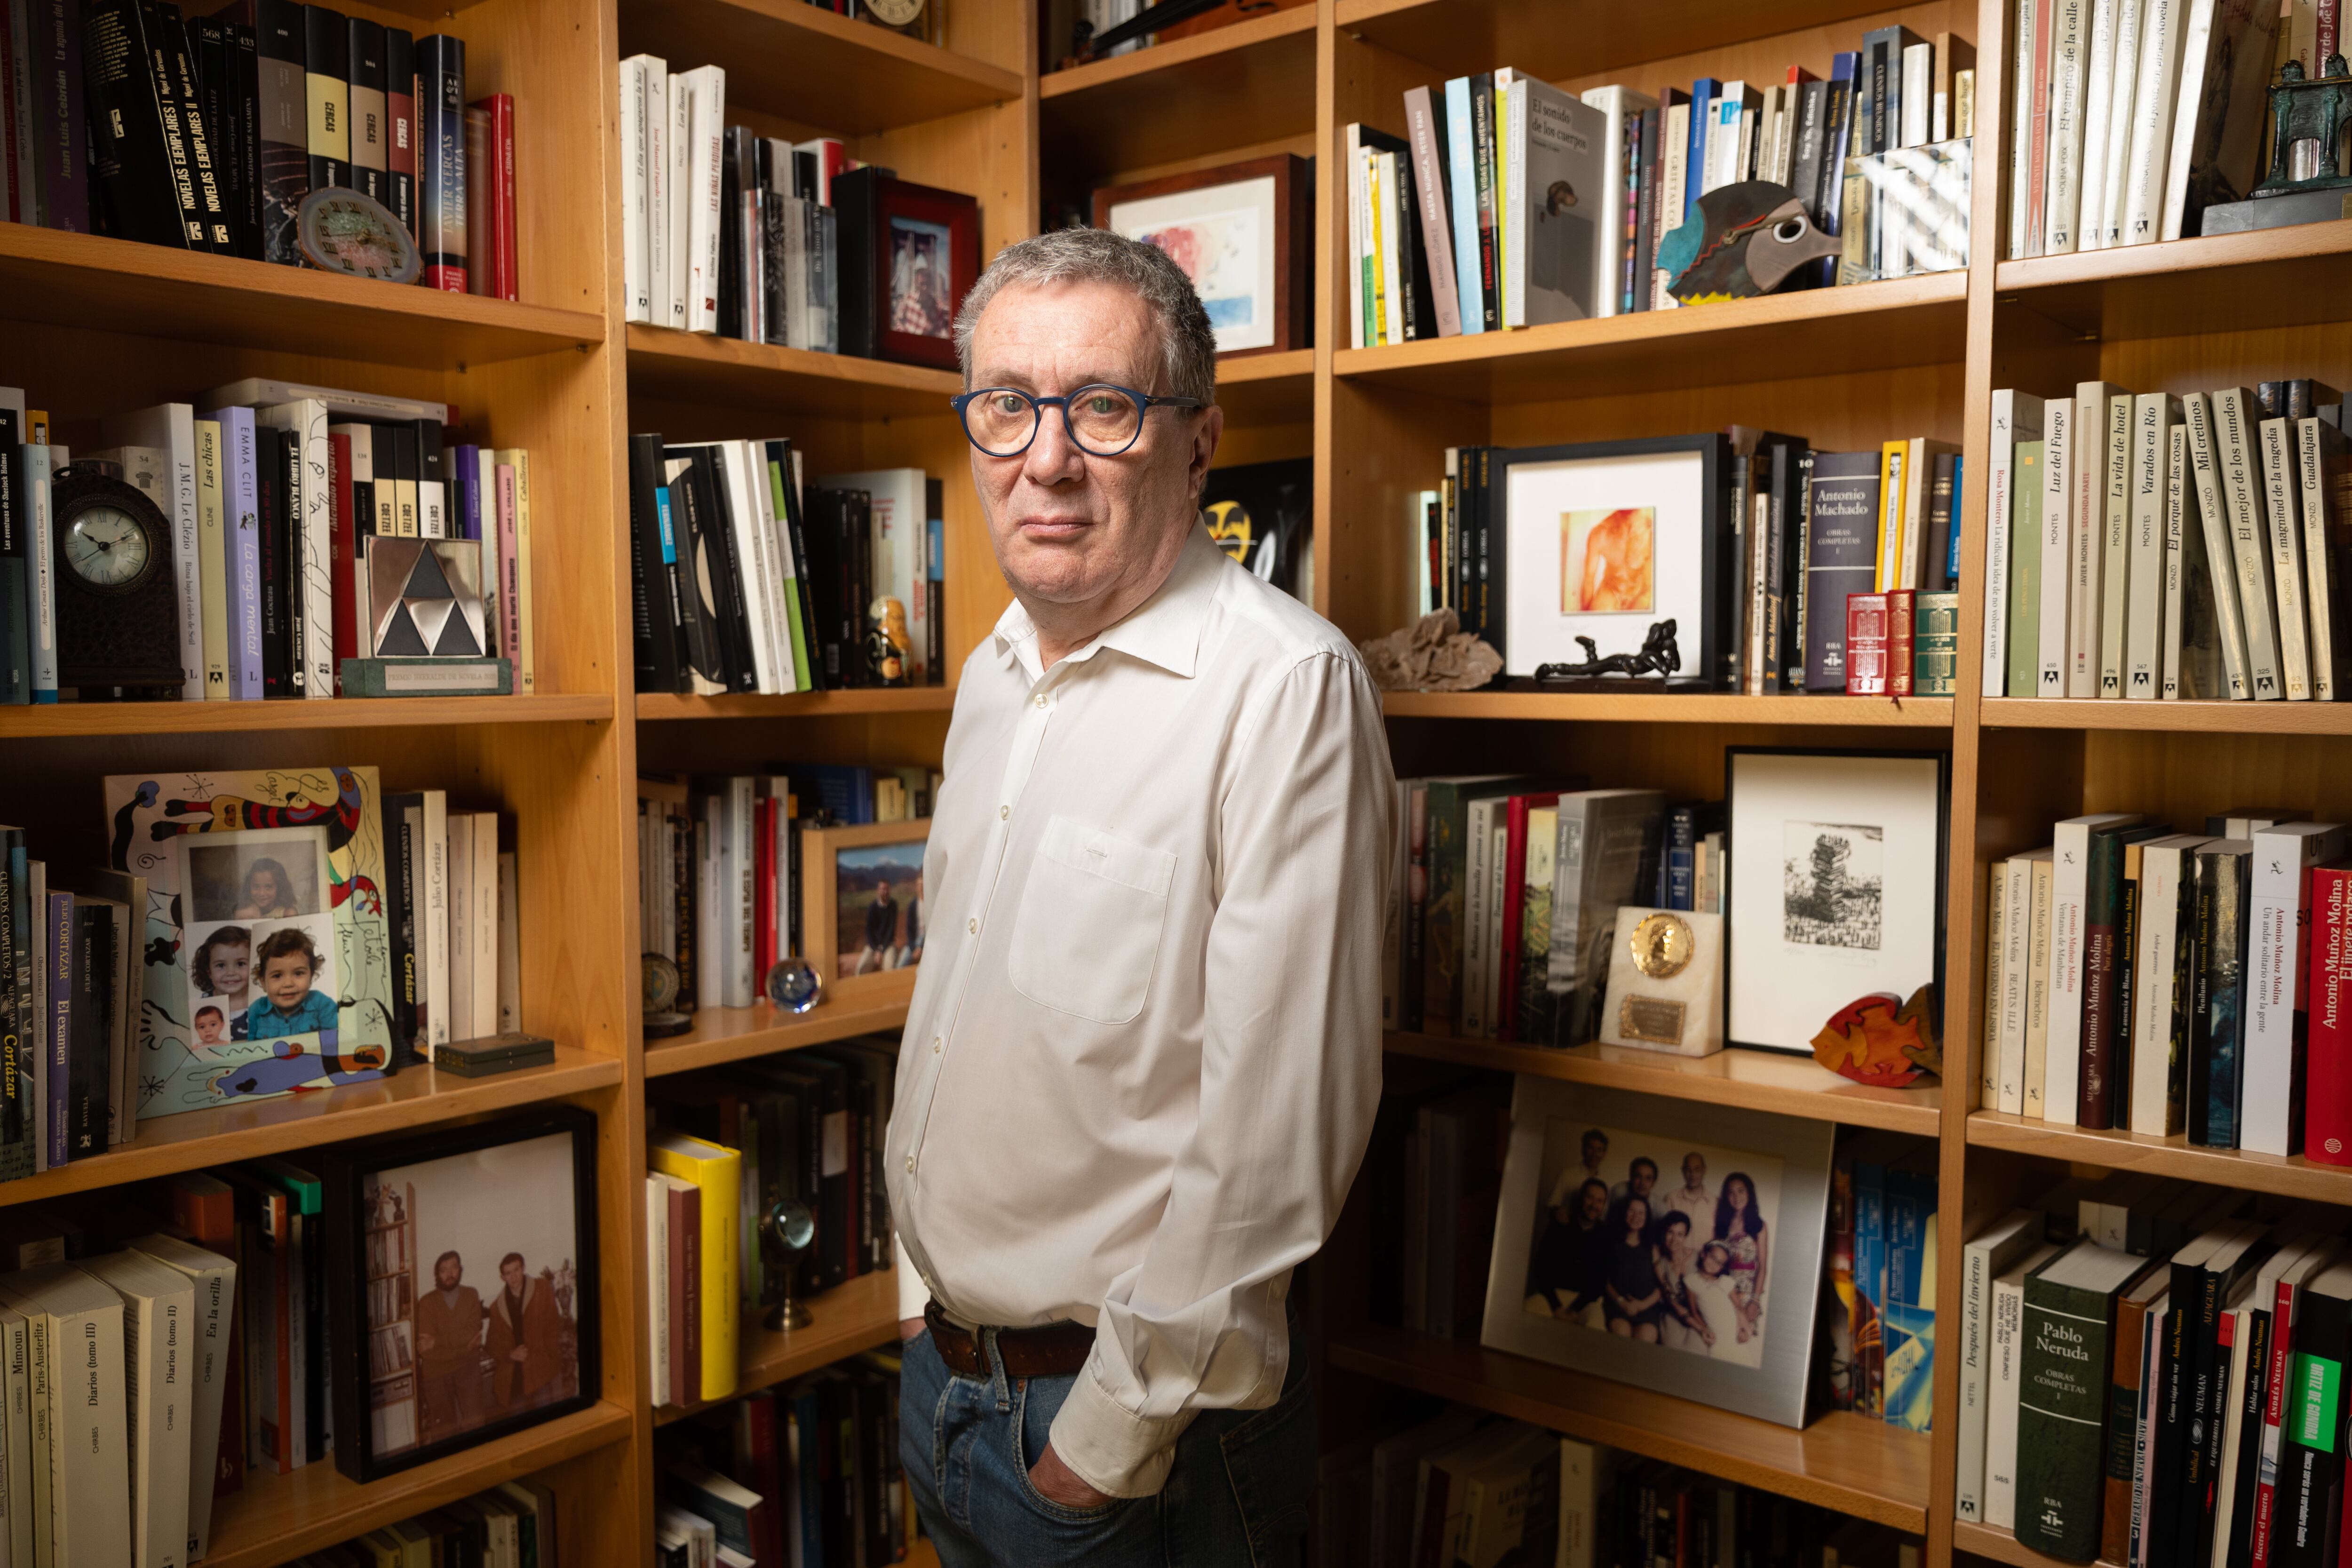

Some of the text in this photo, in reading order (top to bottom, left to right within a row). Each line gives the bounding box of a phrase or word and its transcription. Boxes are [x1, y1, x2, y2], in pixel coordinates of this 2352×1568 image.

[202, 29, 221, 40] 568
[2065, 1, 2077, 30] calle
[2063, 47, 2075, 62] de
[2064, 34, 2076, 44] la
[54, 3, 72, 179] Juan Luis Cebrián La agonía del
[325, 102, 334, 133] CERCAS
[1542, 104, 1571, 123] sonido
[2059, 118, 2070, 131] El
[164, 107, 186, 165] EJEMPLARES
[190, 111, 211, 169] EJEMPLARES
[397, 117, 408, 150] CERCAS
[1532, 120, 1587, 150] de los cuerpos
[177, 168, 196, 209] NOVELAS
[201, 172, 221, 212] NOVELAS
[202, 431, 214, 489] Las chicas
[2050, 411, 2063, 493] Luz del Fuego
[2112, 404, 2126, 499] La vida de hotel
[2142, 407, 2156, 495] Varados en Río
[2191, 401, 2216, 519] MONZÓ Mil cretinos
[2224, 396, 2252, 541] El mejor de los mundos
[2304, 425, 2315, 491] Guadalajara
[179, 462, 193, 549] J. M. G. Le Clézio
[1814, 502, 1868, 517] Machado
[1818, 488, 1866, 502] Antonio
[1995, 490, 2003, 525] Montero
[2168, 432, 2182, 551] El porqué de las cosas
[2270, 427, 2289, 565] La magnitud de la tragedia
[240, 427, 259, 655] EMMA CLIT La carga mental
[0, 871, 9, 913] CUENTOS
[2263, 907, 2272, 918] Un
[59, 921, 72, 980] CORTÁZAR
[2056, 903, 2067, 988] Ventanas de Manhattan
[2262, 920, 2272, 944] andar
[2260, 946, 2270, 979] solitario
[2321, 879, 2343, 1029] Antonio Muñoz Molina
[2340, 966, 2352, 980] El
[57, 1000, 69, 1014] El
[2197, 978, 2207, 1014] Plenilunio
[2259, 980, 2268, 1001] entre
[57, 1016, 68, 1065] examen
[2257, 1011, 2266, 1033] gente
[4, 1034, 18, 1099] Cortázar
[86, 1322, 97, 1337] III)
[204, 1276, 222, 1382] CHIRBES En la orilla
[1965, 1256, 1980, 1368] Después del invierno
[13, 1329, 24, 1375] Mimoun
[166, 1305, 178, 1384] Diarios (tomo II)
[2035, 1337, 2090, 1362] Neruda
[2042, 1322, 2083, 1344] Pablo
[35, 1322, 44, 1395] Paris-Austerlitz
[87, 1340, 98, 1369] (tomo
[2272, 1350, 2283, 1384] NEUMAN
[88, 1371, 98, 1407] Diarios
[2188, 1279, 2216, 1483] Umbilical NEUMAN ALFAGUARA
[2269, 1385, 2280, 1418] ANDRÉS
[2304, 1362, 2325, 1441] ORTIZ DE GONDRA
[2259, 1493, 2269, 1520] muerto
[2255, 1532, 2265, 1560] Hacerse
